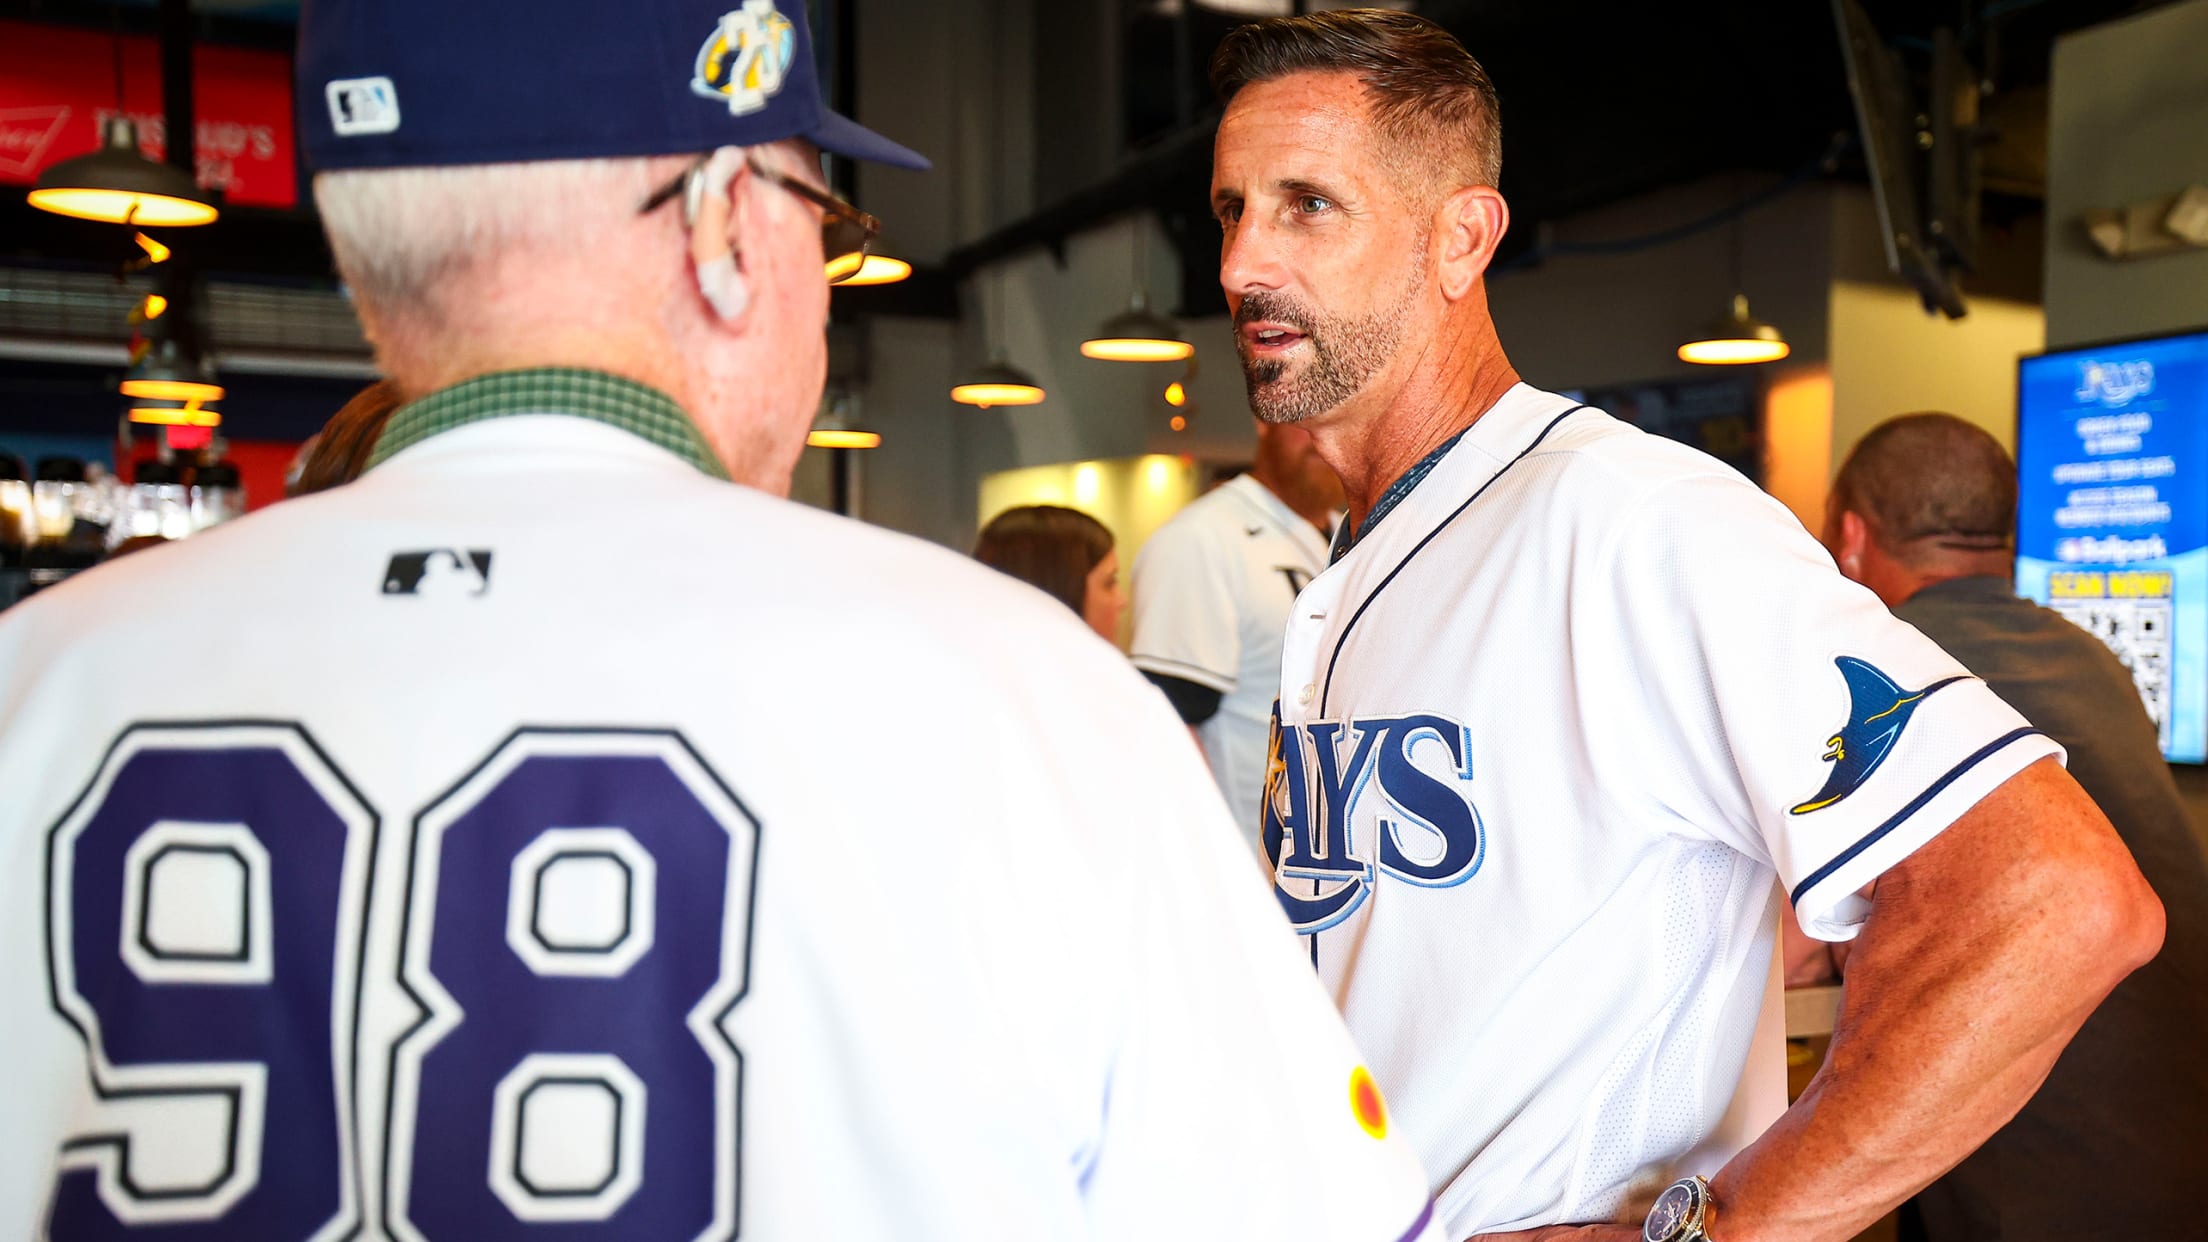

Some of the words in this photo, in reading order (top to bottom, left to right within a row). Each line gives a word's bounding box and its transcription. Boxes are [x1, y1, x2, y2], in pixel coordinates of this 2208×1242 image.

[195, 119, 275, 159] UD'S
[2050, 571, 2104, 597] SCAN
[2107, 569, 2172, 597] NOW!
[44, 718, 761, 1242] 98
